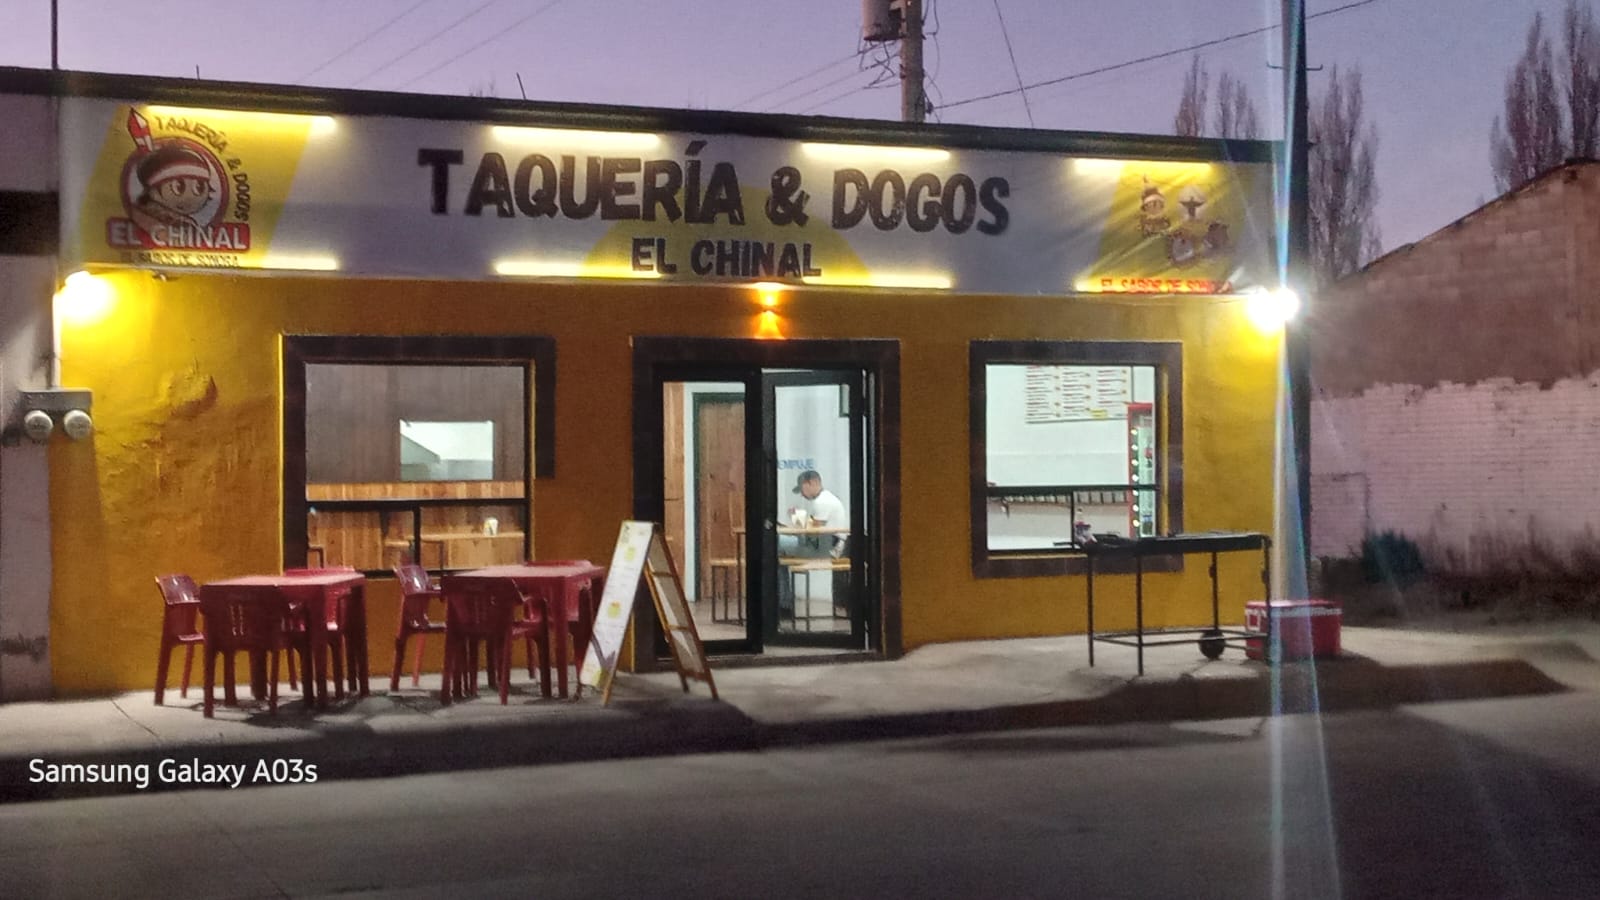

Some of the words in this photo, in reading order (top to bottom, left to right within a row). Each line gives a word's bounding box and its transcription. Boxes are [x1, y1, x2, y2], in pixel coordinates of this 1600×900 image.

[233, 173, 251, 221] DOGOS
[417, 138, 745, 226] TAQUERÍA
[765, 166, 811, 227] &
[831, 168, 1011, 236] DOGOS
[110, 221, 142, 245] EL
[151, 223, 247, 250] CHINAL
[632, 238, 677, 274] EL
[691, 239, 822, 278] CHINAL
